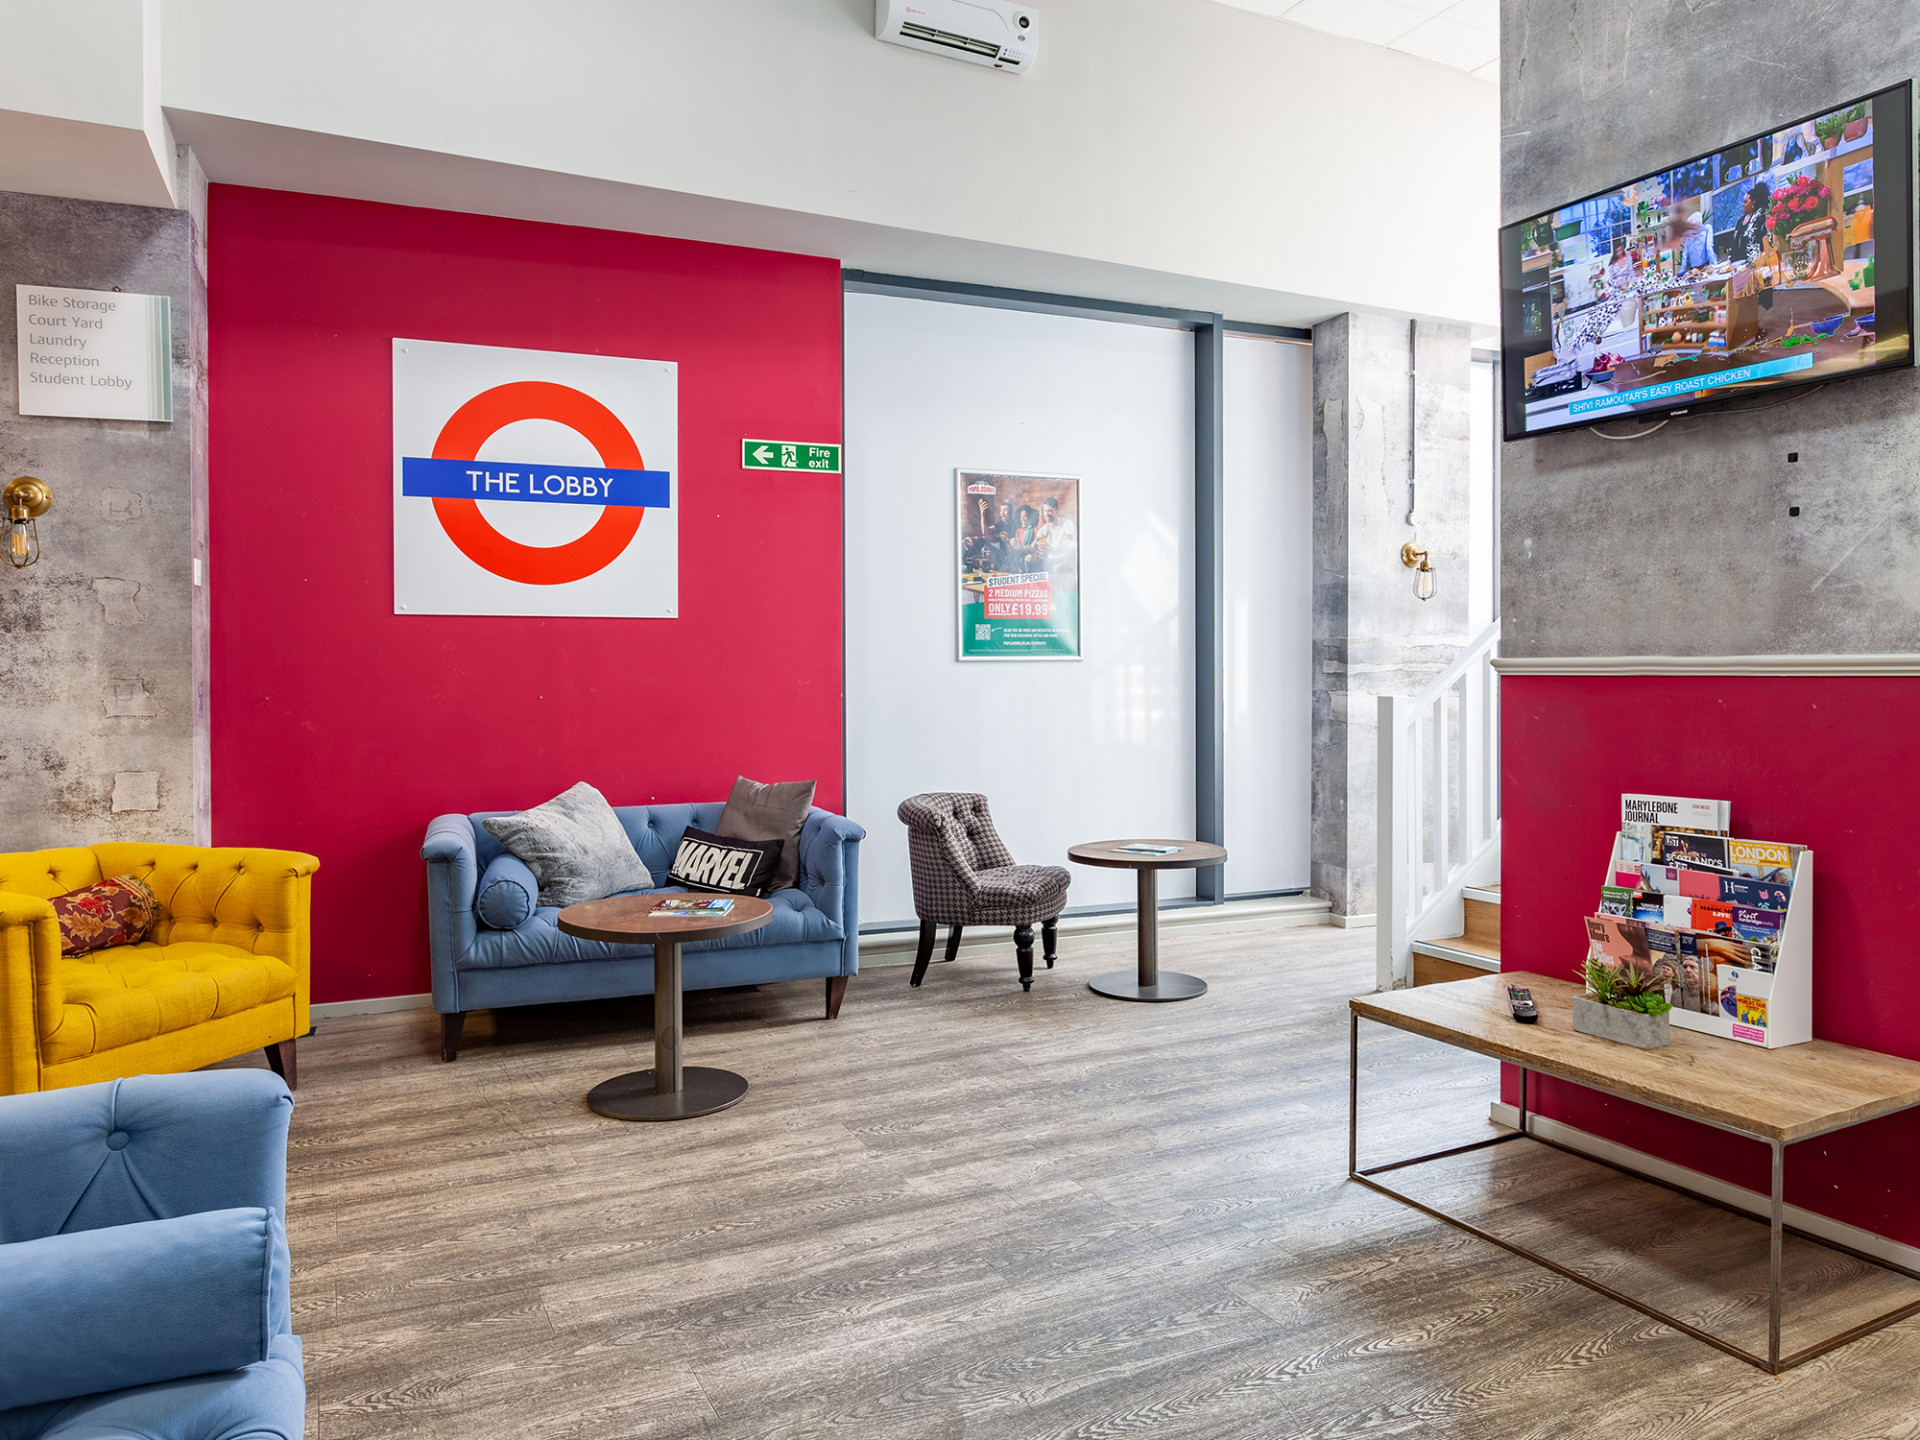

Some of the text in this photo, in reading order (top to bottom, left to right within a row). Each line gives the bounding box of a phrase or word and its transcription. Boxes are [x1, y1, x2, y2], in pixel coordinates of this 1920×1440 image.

[28, 294, 116, 313] Bike Storage
[28, 314, 103, 330] Court Yard
[29, 333, 87, 349] Laundry
[30, 352, 100, 368] Reception
[30, 372, 133, 391] Student Lobby
[1572, 369, 1751, 413] SHIVI RAMOUTAR'S EASY ROAST CHICKEN
[808, 447, 831, 458] Fire
[808, 458, 830, 469] exit
[466, 470, 614, 498] THE LOBBY
[988, 572, 1047, 587] STUDENT SPECIAL
[988, 589, 1048, 598] 2 MEDIUM PIZZAS
[988, 603, 1048, 616] ONLY £19.99
[1624, 799, 1678, 814] MARYLEBONE
[1624, 810, 1660, 824] JOURNAL
[1729, 845, 1788, 862] LONDON
[1730, 857, 1760, 865] PLANNER
[672, 840, 754, 890] MARVEL
[1700, 904, 1723, 913] MAGIC
[1712, 911, 1731, 919] LIVE
[1738, 909, 1759, 920] Visit
[1589, 928, 1610, 943] Moore
